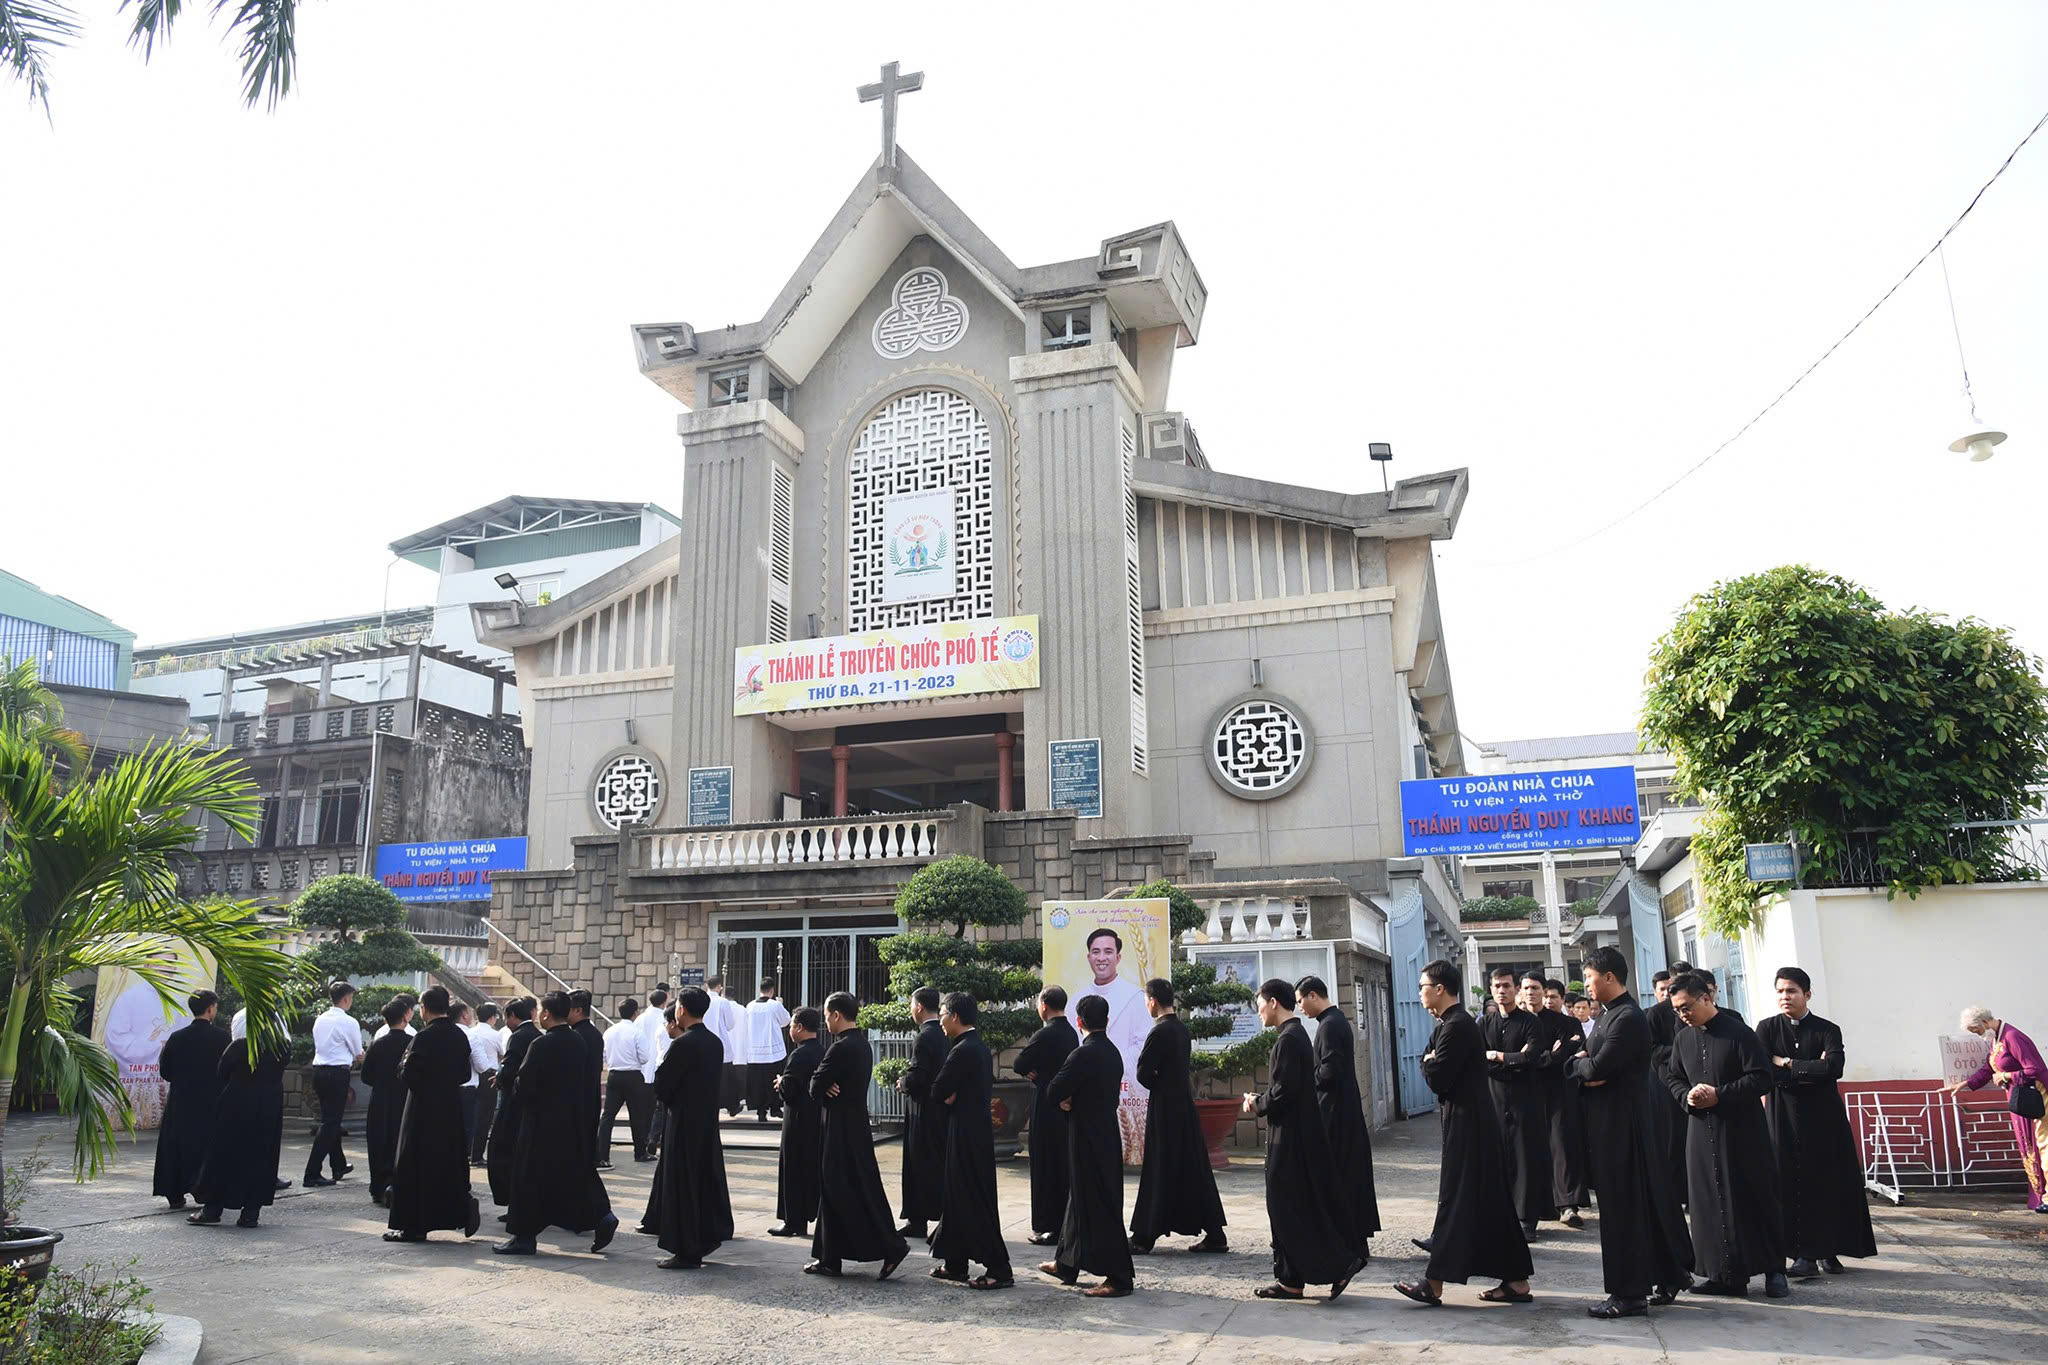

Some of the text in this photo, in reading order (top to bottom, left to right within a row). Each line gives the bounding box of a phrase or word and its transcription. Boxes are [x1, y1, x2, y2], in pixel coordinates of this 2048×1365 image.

[768, 652, 815, 684] THÁNH
[819, 643, 835, 679] LỄ
[840, 639, 895, 677] TRUYỀN
[900, 637, 941, 671] CHỨC
[946, 632, 976, 666] PHÓ
[981, 626, 1000, 662] TẾ
[808, 675, 955, 700] THỨ BA, 21-11-2023
[1439, 772, 1595, 796] TU ĐOÀN NHÀ CHÚA
[1451, 799, 1469, 808] TU
[1474, 796, 1505, 807] VIỆN
[1519, 792, 1548, 804] NHÀ
[1553, 790, 1584, 801] THỜ
[1408, 811, 1461, 837] THÁNH
[1537, 809, 1570, 830] DUY
[1578, 805, 1635, 828] KHANG
[405, 841, 496, 857] TU ĐOÀN NHÀ CHÚA
[424, 859, 442, 867] VIỆN
[449, 856, 467, 865] NHÀ
[470, 856, 489, 864] THỜ
[383, 871, 413, 888] THÁNH
[457, 870, 478, 885] DUY
[1963, 1038, 1982, 1053] TÔN
